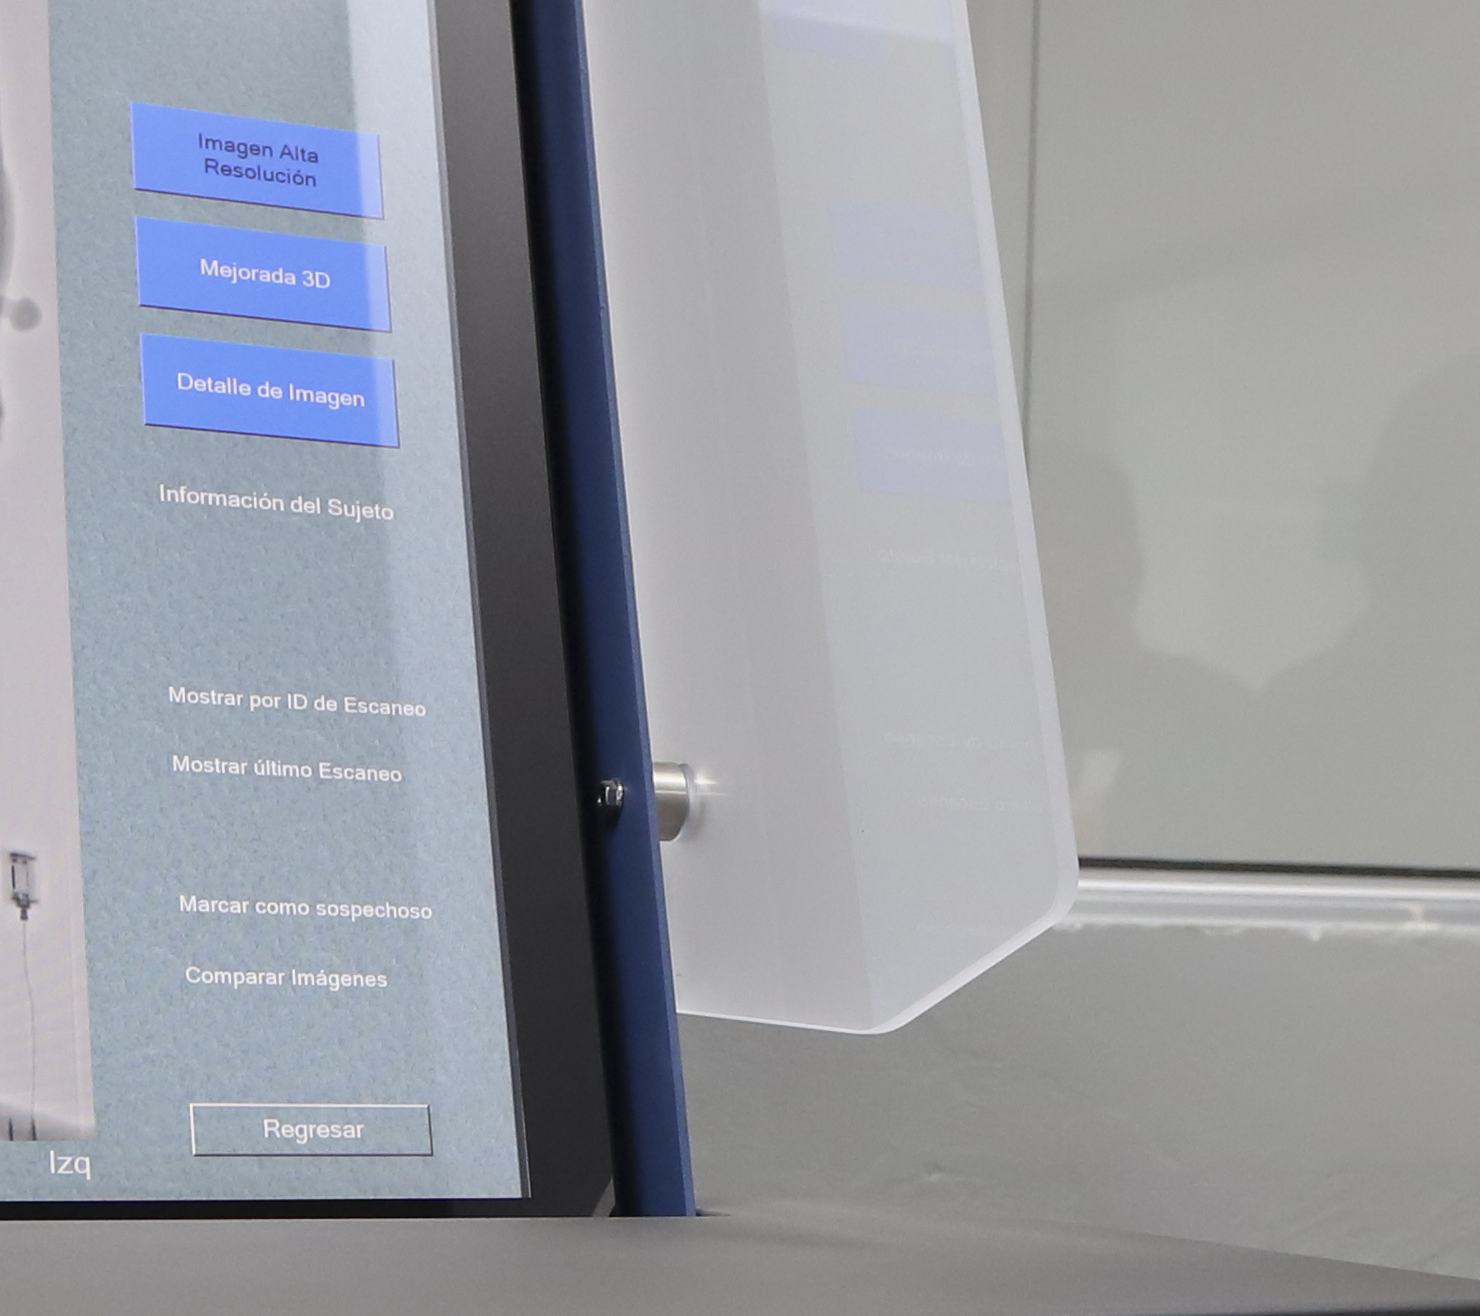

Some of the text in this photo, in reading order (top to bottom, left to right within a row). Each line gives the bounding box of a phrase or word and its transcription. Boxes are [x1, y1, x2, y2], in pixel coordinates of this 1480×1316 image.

[198, 133, 319, 164] Imagen Alta
[204, 158, 317, 187] Resolución
[200, 258, 331, 289] Mejorada 3D
[177, 372, 366, 410] Detalle de Imagen
[159, 484, 395, 524] Información del Sujeto
[169, 686, 427, 717] Mostrar por ID de Escaneo
[172, 755, 403, 782] Mostrar último Escaneo
[179, 895, 433, 922] Marcar como sospechoso
[185, 966, 388, 991] Comparar Imágenes
[263, 1119, 365, 1144] Regresar
[49, 1151, 93, 1182] Izq
